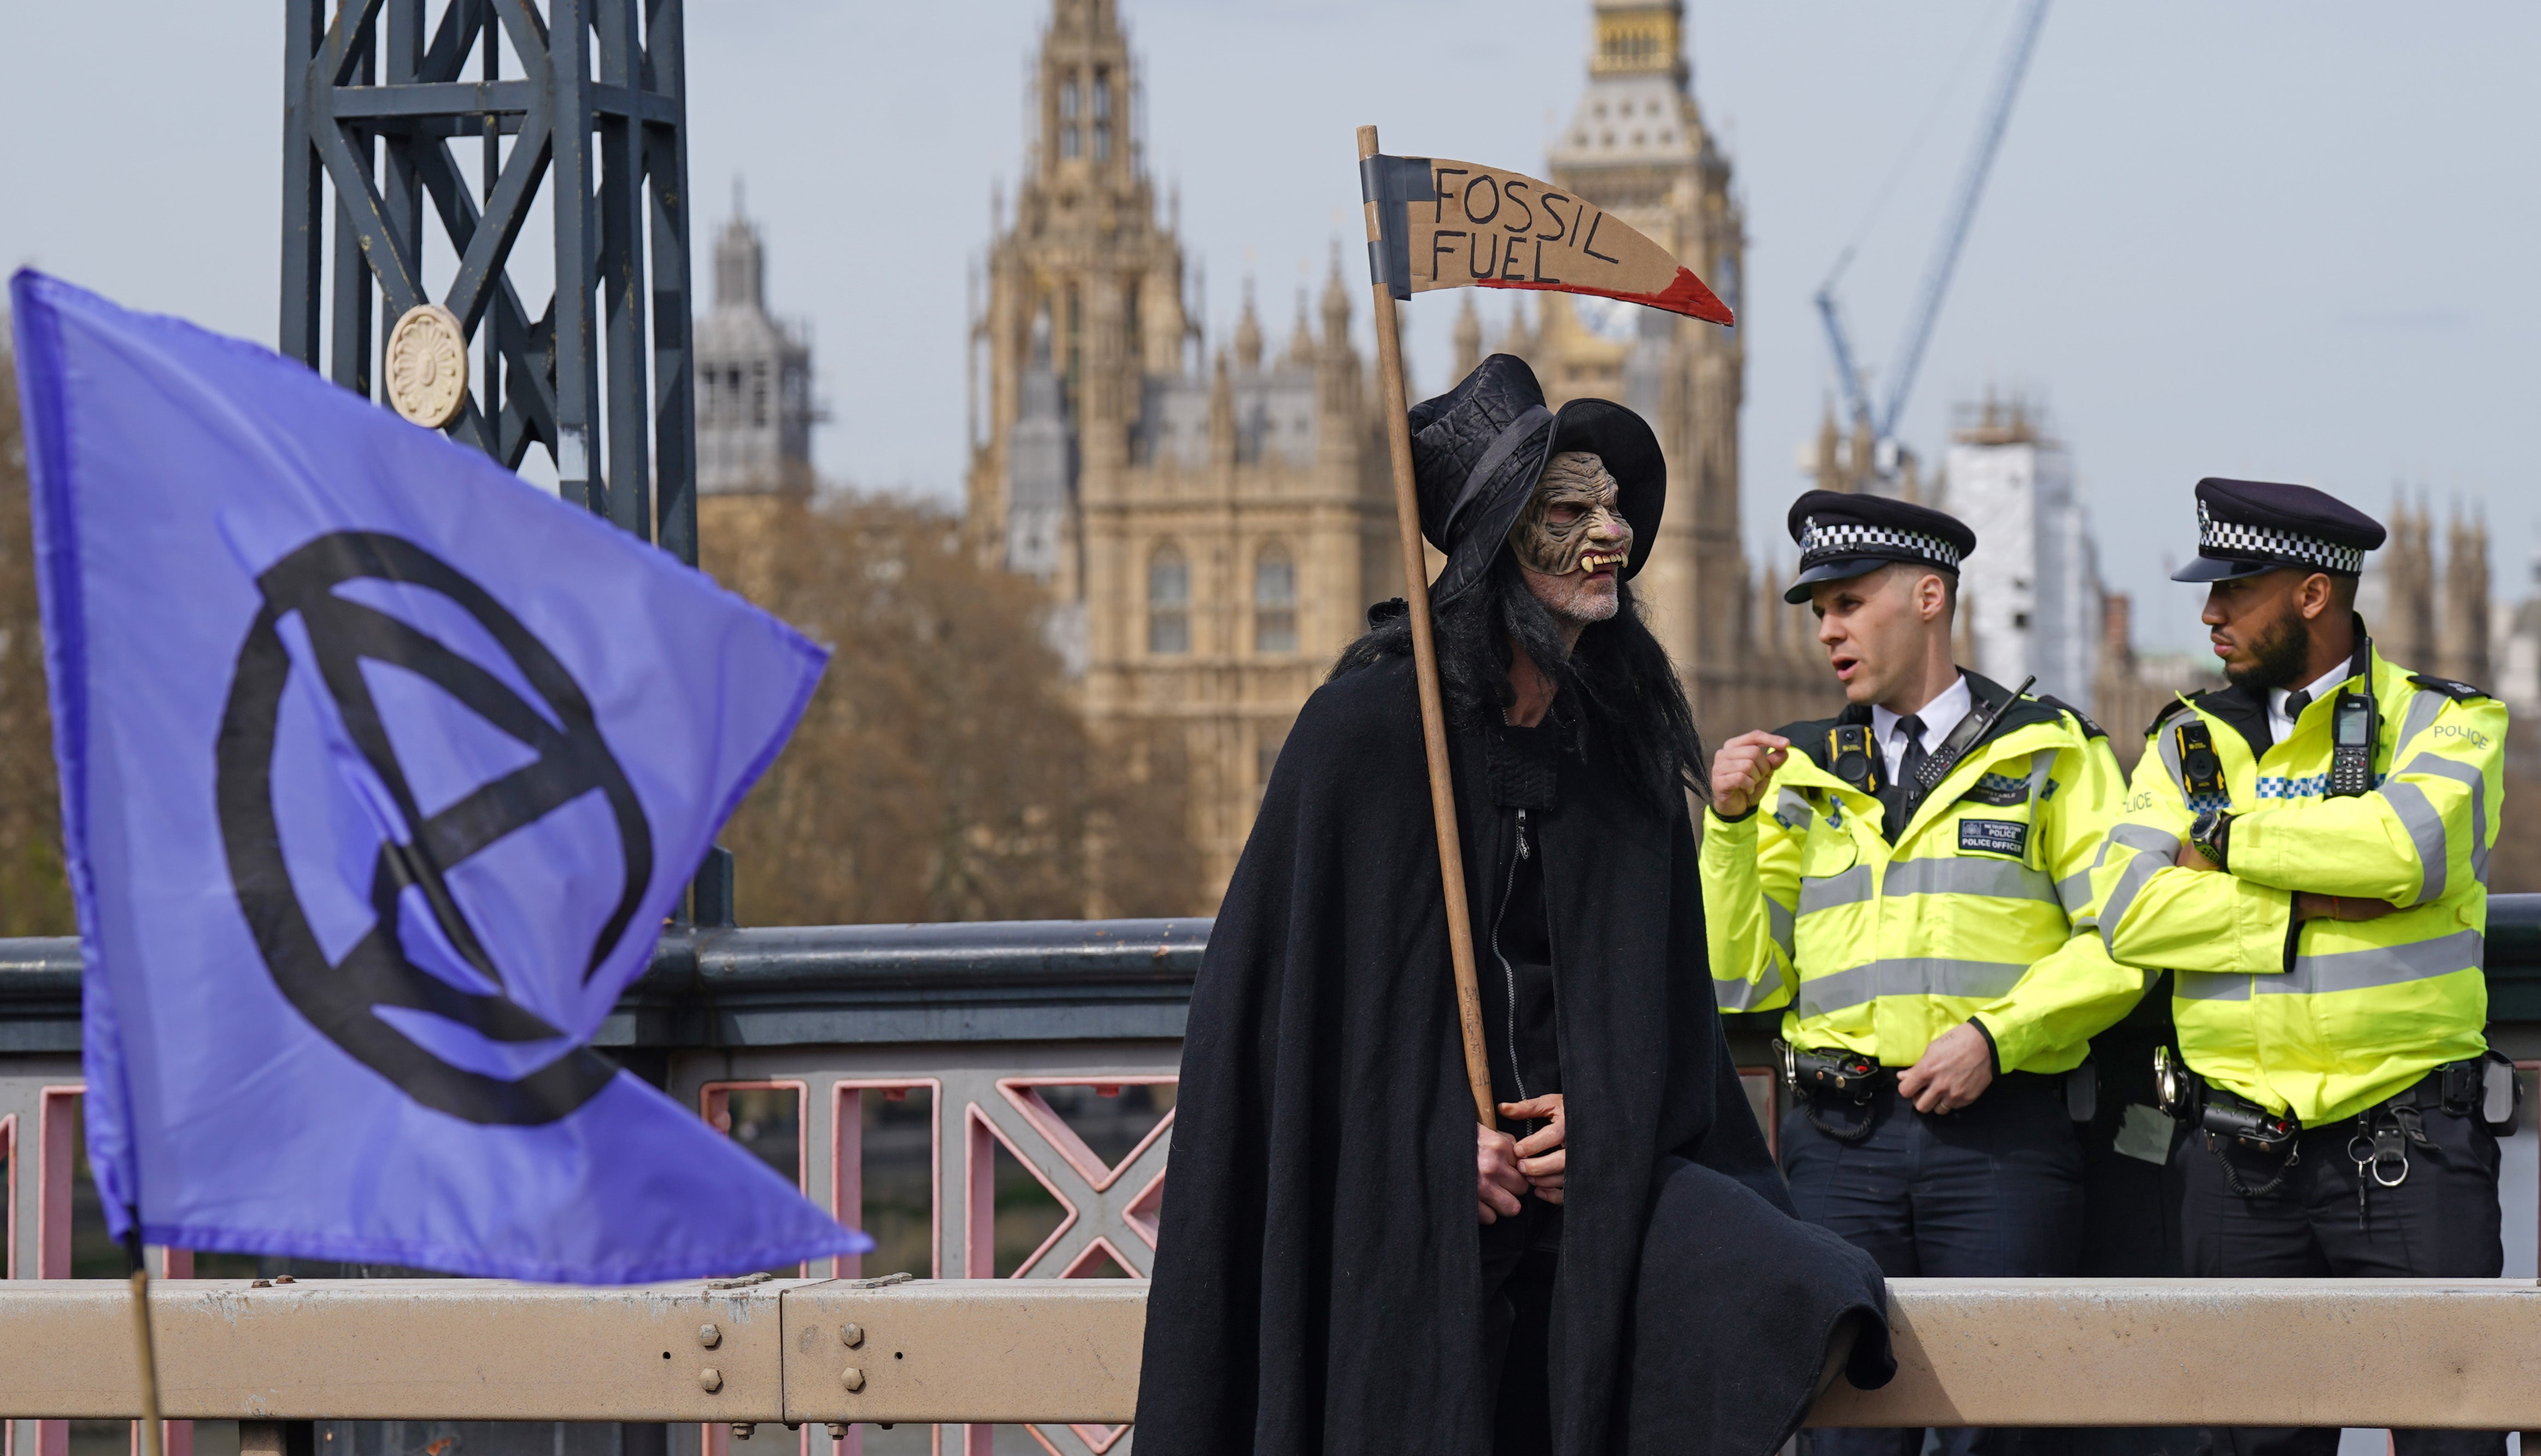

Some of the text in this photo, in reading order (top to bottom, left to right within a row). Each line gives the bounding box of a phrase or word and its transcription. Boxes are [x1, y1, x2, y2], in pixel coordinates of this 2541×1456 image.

[1435, 168, 1619, 265] FOSSIL
[1432, 230, 1560, 284] FUEL
[2434, 725, 2489, 750] POLICE
[2126, 792, 2152, 813] LICE
[1962, 838, 2022, 853] POLICE OFFICER
[1988, 829, 2016, 839] POLICE
